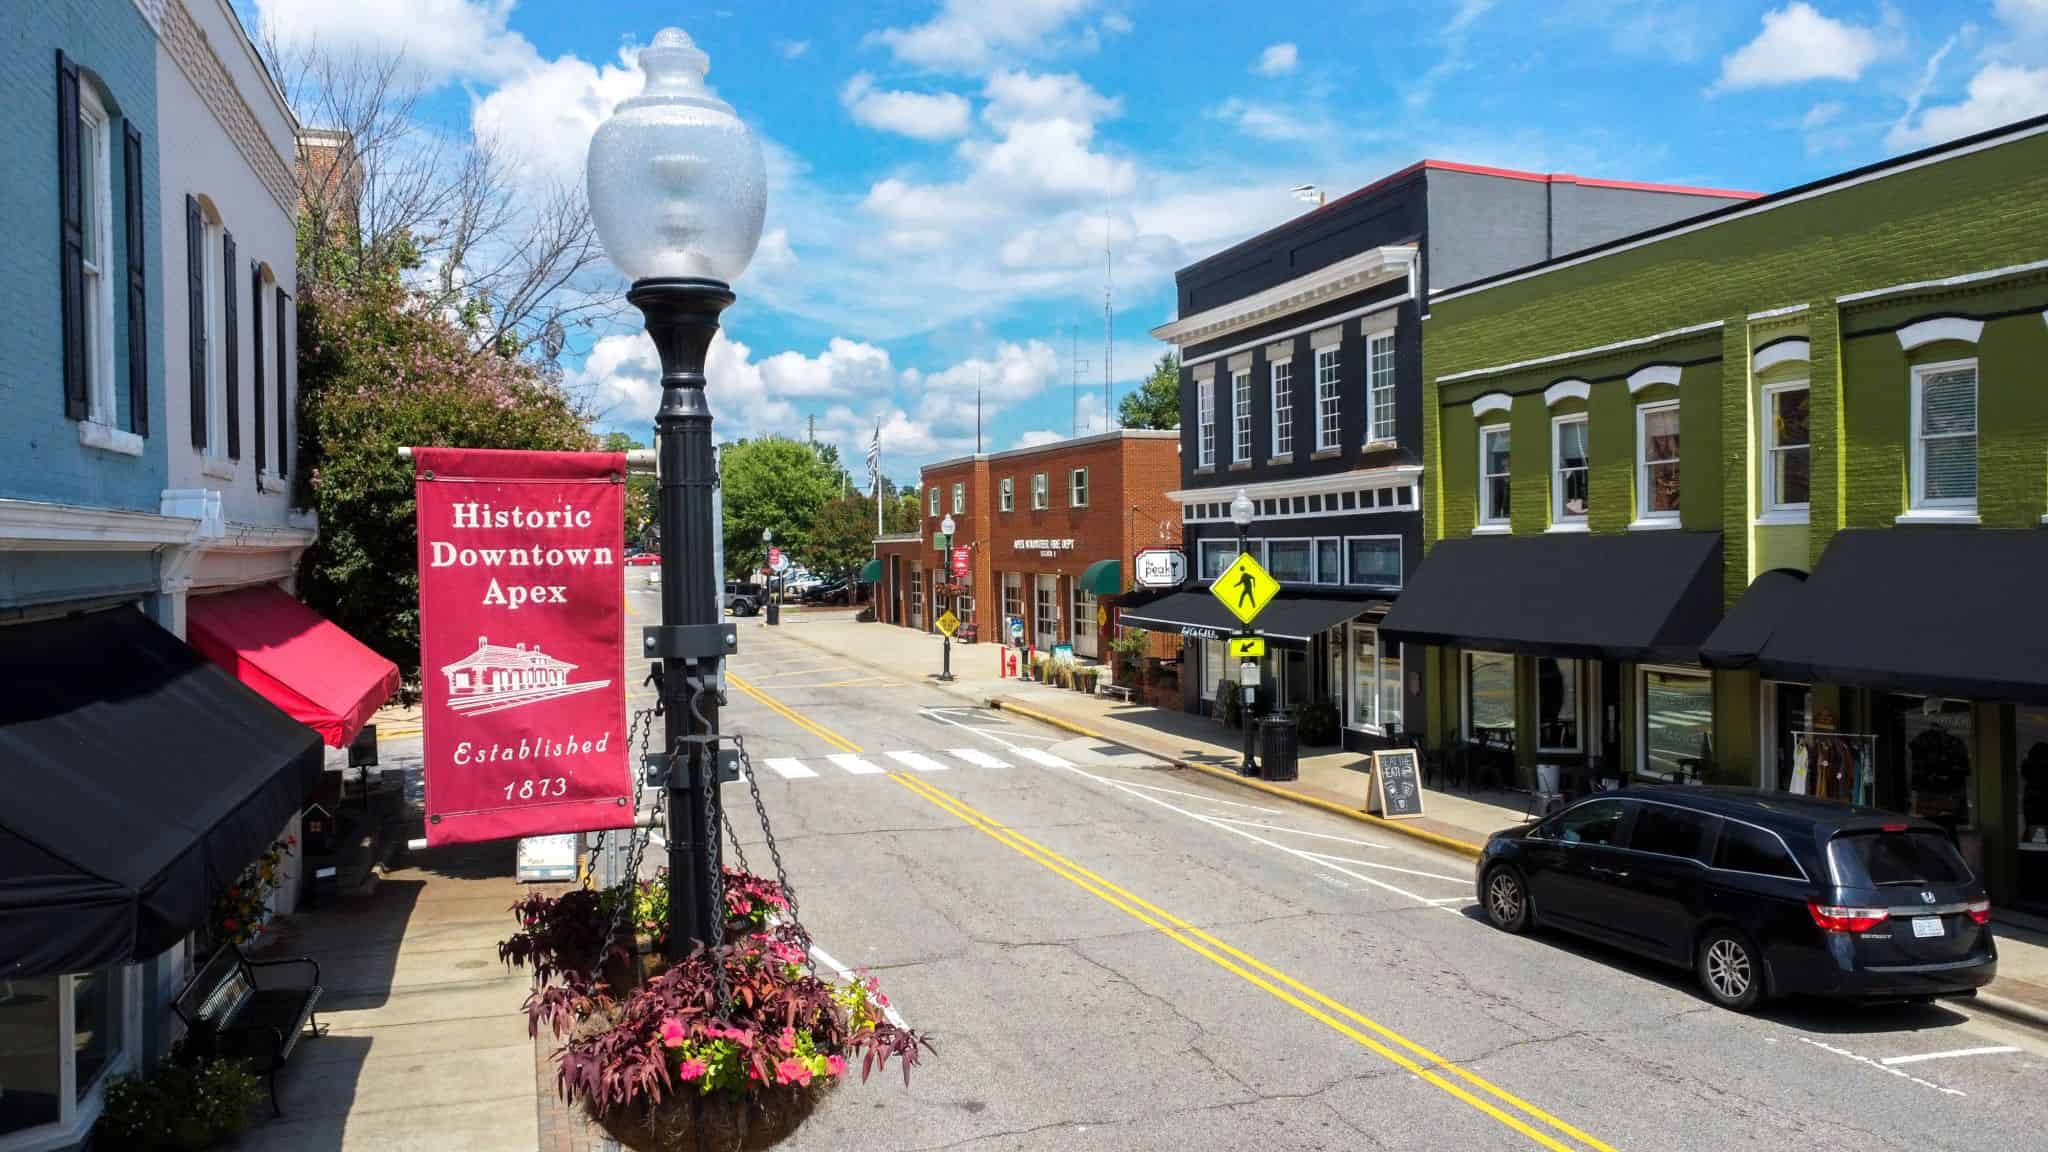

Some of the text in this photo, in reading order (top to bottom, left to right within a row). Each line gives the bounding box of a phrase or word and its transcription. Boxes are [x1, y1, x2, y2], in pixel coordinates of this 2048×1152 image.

[452, 502, 592, 529] Historic
[430, 541, 614, 568] Downtown
[482, 577, 568, 609] Apex
[453, 731, 610, 765] Established
[504, 777, 567, 801] 1873
